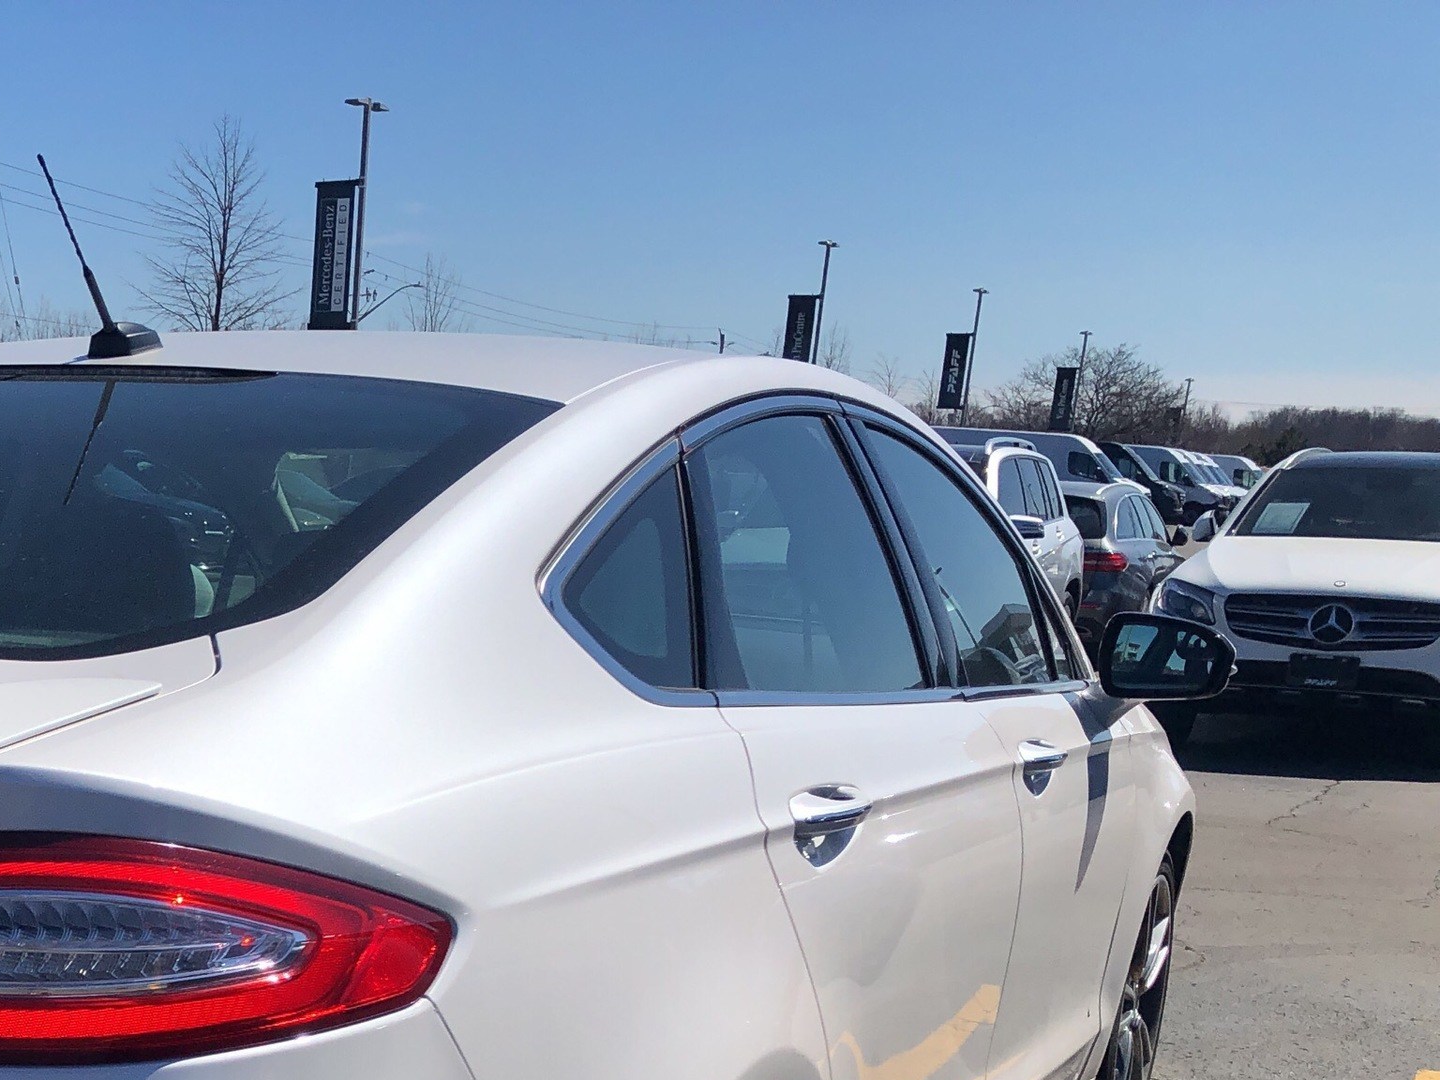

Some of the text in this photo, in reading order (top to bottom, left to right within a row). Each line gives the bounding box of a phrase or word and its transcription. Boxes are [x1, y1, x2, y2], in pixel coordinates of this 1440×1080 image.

[317, 205, 336, 306] Mercedes-Benz
[333, 204, 348, 306] CERTIFIED
[946, 348, 961, 394] PFAFF
